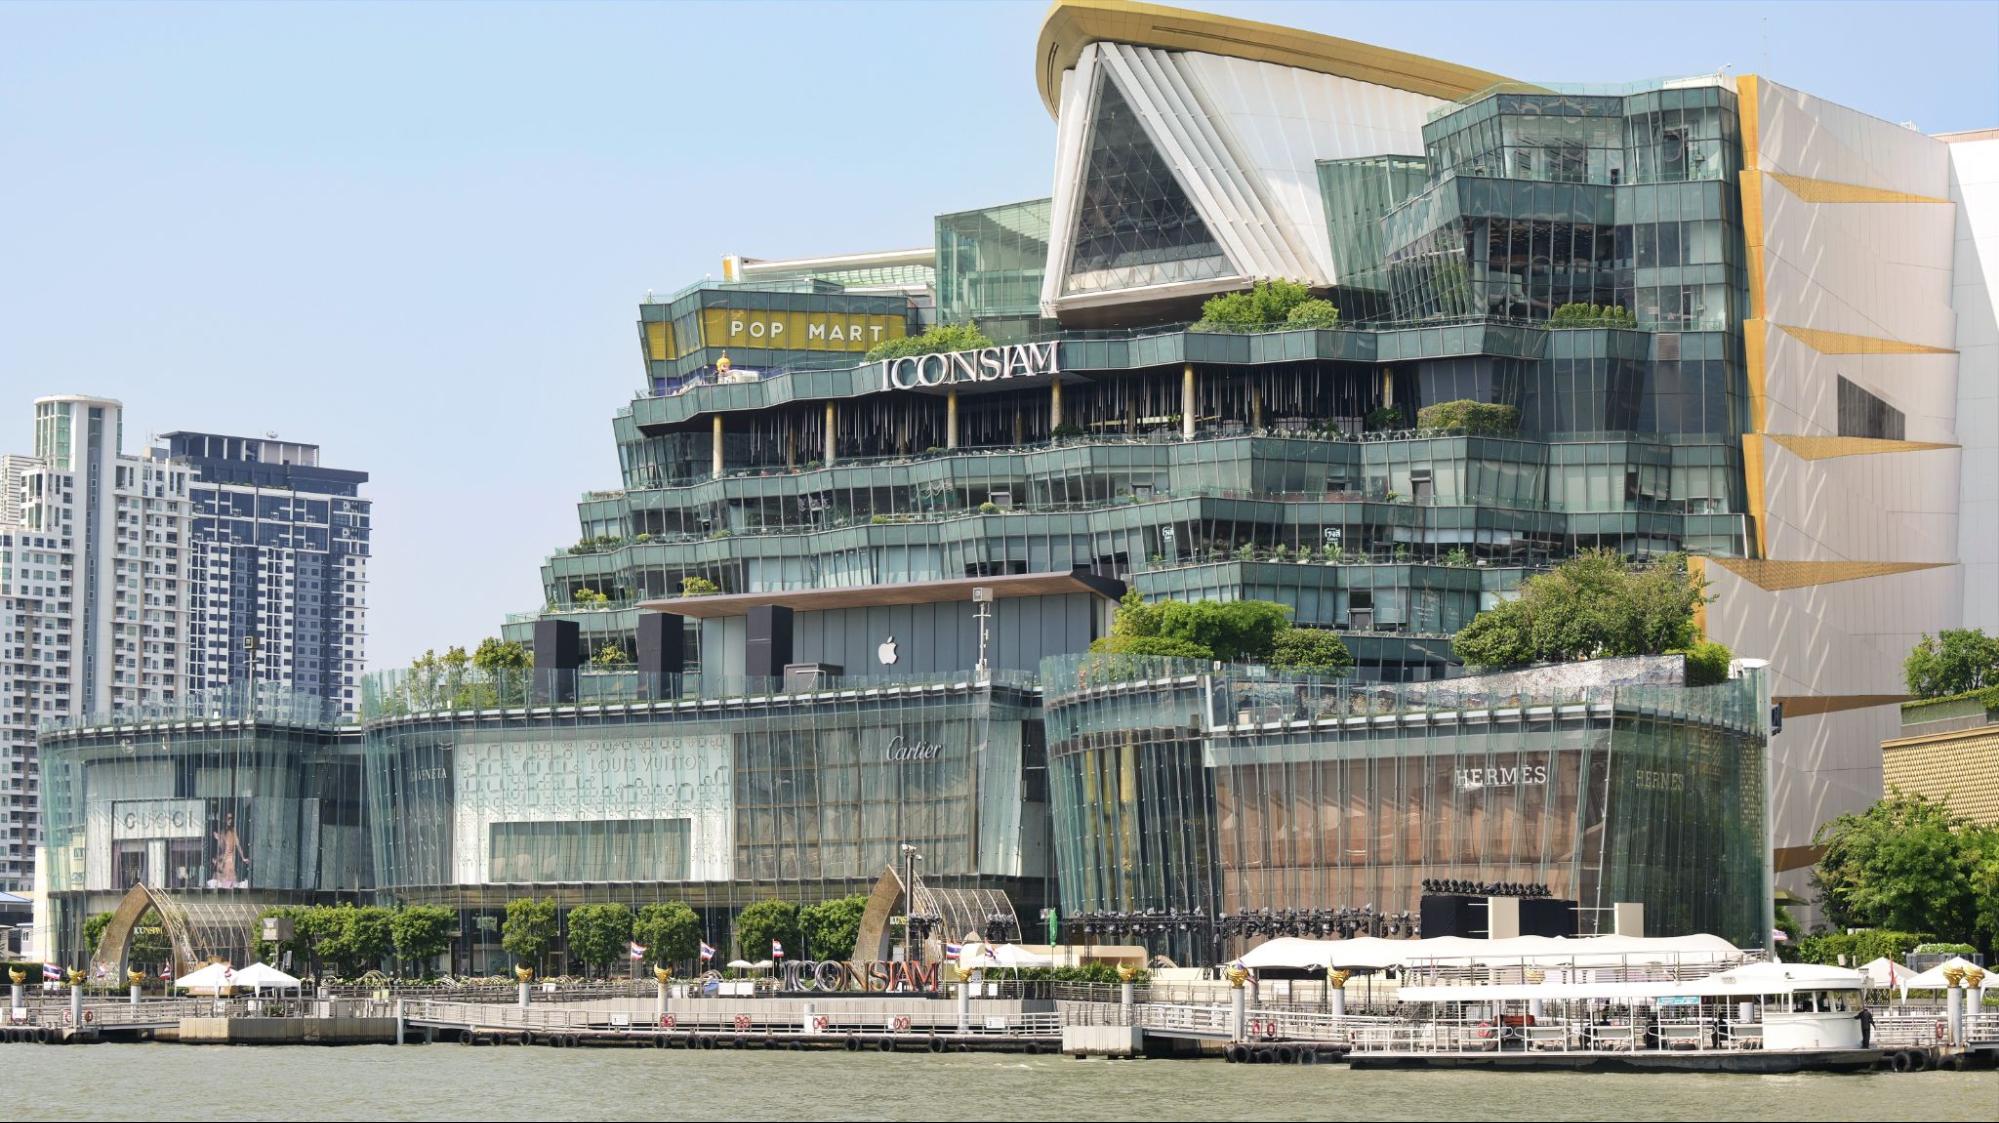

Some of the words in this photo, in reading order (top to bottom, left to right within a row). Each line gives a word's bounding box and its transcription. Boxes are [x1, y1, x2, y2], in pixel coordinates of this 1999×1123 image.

[730, 320, 784, 338] POP
[809, 323, 884, 342] MART
[881, 340, 1060, 391] ICONSIAM
[887, 736, 942, 761] Cartier
[591, 758, 636, 774] LOUIS
[643, 755, 709, 773] VUITTON
[125, 811, 193, 830] GUCCI
[784, 960, 939, 993] ICONSIAM
